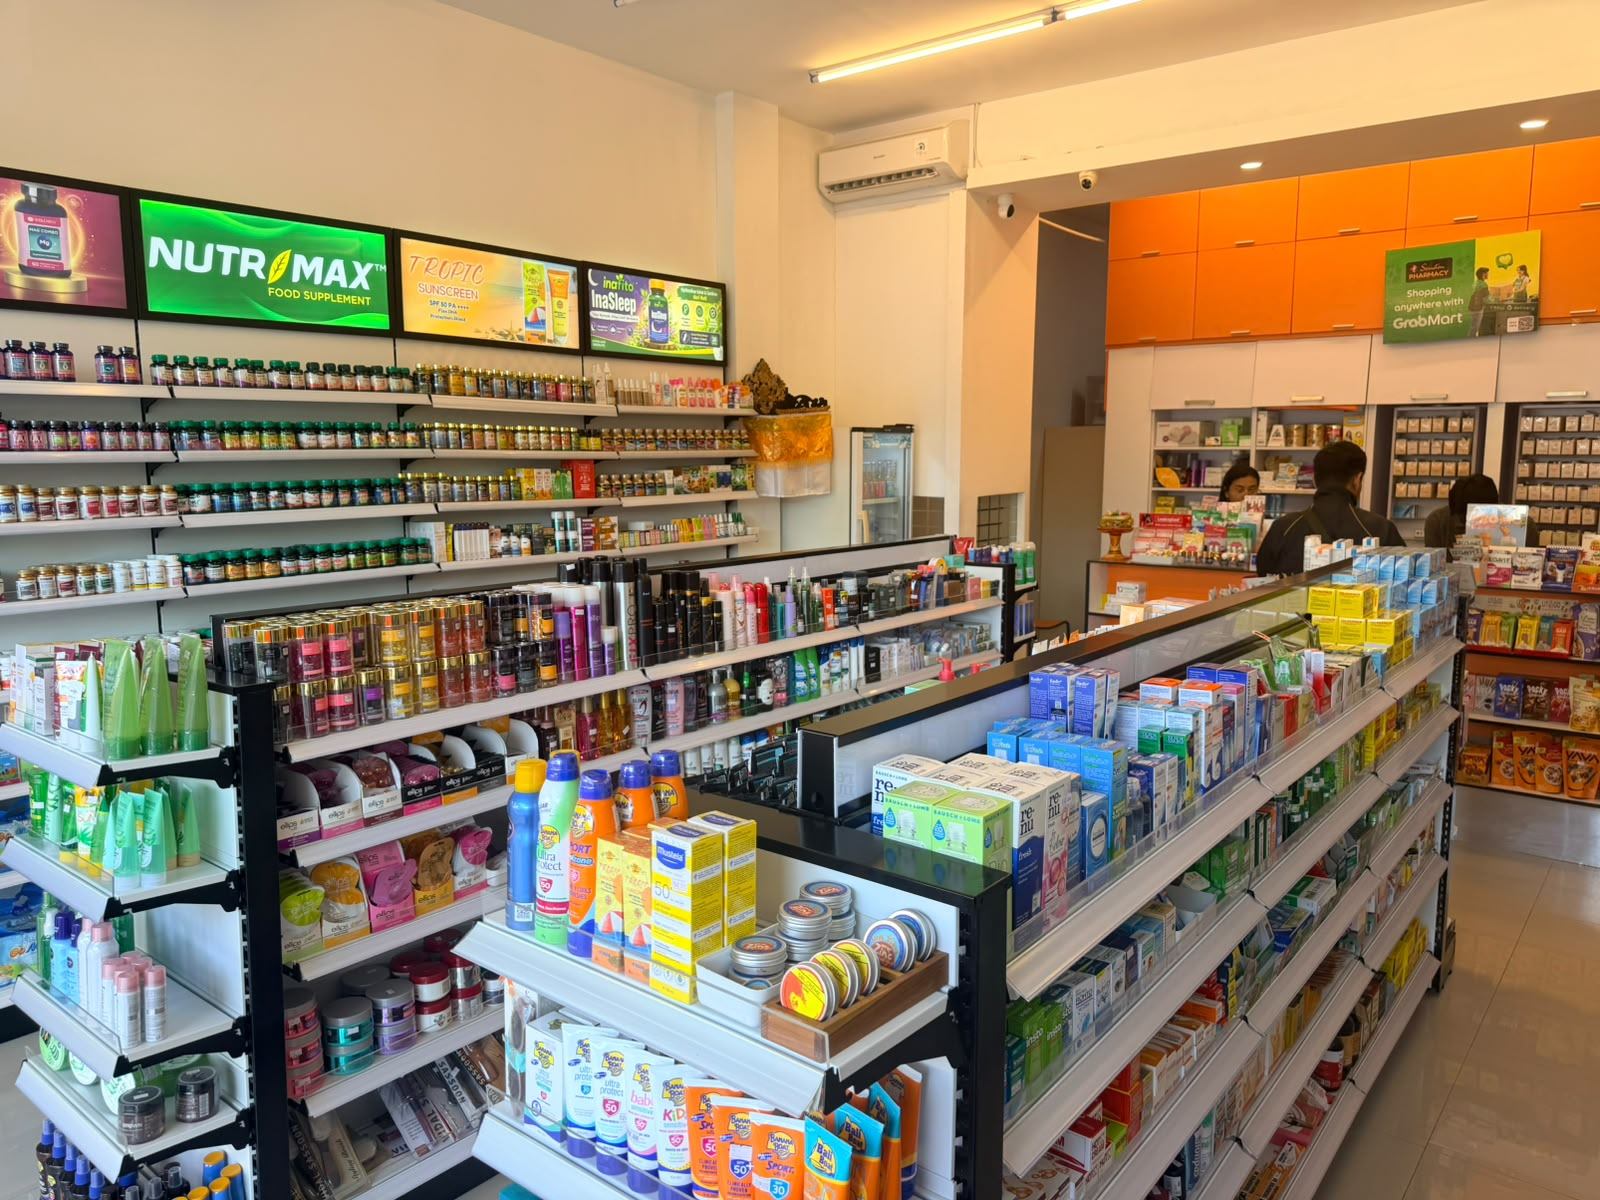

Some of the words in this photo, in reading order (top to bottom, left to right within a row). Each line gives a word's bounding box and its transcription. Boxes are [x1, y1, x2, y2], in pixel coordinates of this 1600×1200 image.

[410, 255, 484, 285] TROPIC
[1408, 269, 1449, 280] PHARMACY
[268, 287, 301, 300] FOOD
[304, 290, 371, 306] SUPPLEMENT
[418, 282, 479, 299] SUNSCREEN
[1407, 286, 1452, 298] Shopping
[591, 289, 637, 315] InaSleep
[1394, 302, 1442, 313] anywhere
[1443, 298, 1464, 307] with
[1393, 312, 1463, 330] GrabMart
[874, 790, 884, 803] n
[885, 797, 909, 808] BAUSCH
[913, 804, 930, 812] LOMB
[1048, 804, 1061, 820] nu
[933, 809, 959, 819] BAUSCH
[963, 816, 981, 824] LOMB
[1020, 819, 1034, 836] nu
[657, 846, 684, 862] Mustela
[1019, 848, 1033, 862] fresh
[1026, 1027, 1044, 1048] insto
[1047, 1023, 1062, 1041] insto
[438, 1060, 467, 1104] SASSOON
[575, 1073, 593, 1081] prote
[604, 1080, 621, 1089] ultra
[599, 1086, 624, 1097] protect
[605, 1103, 617, 1111] 50
[427, 1109, 450, 1143] VIDAL
[845, 1120, 862, 1138] Bali
[768, 1132, 794, 1146] BANANA
[774, 1143, 789, 1152] BOAT
[816, 1143, 833, 1160] Bali
[766, 1160, 794, 1174] SPORT
[819, 1154, 833, 1171] Boat
[772, 1185, 785, 1194] 30
